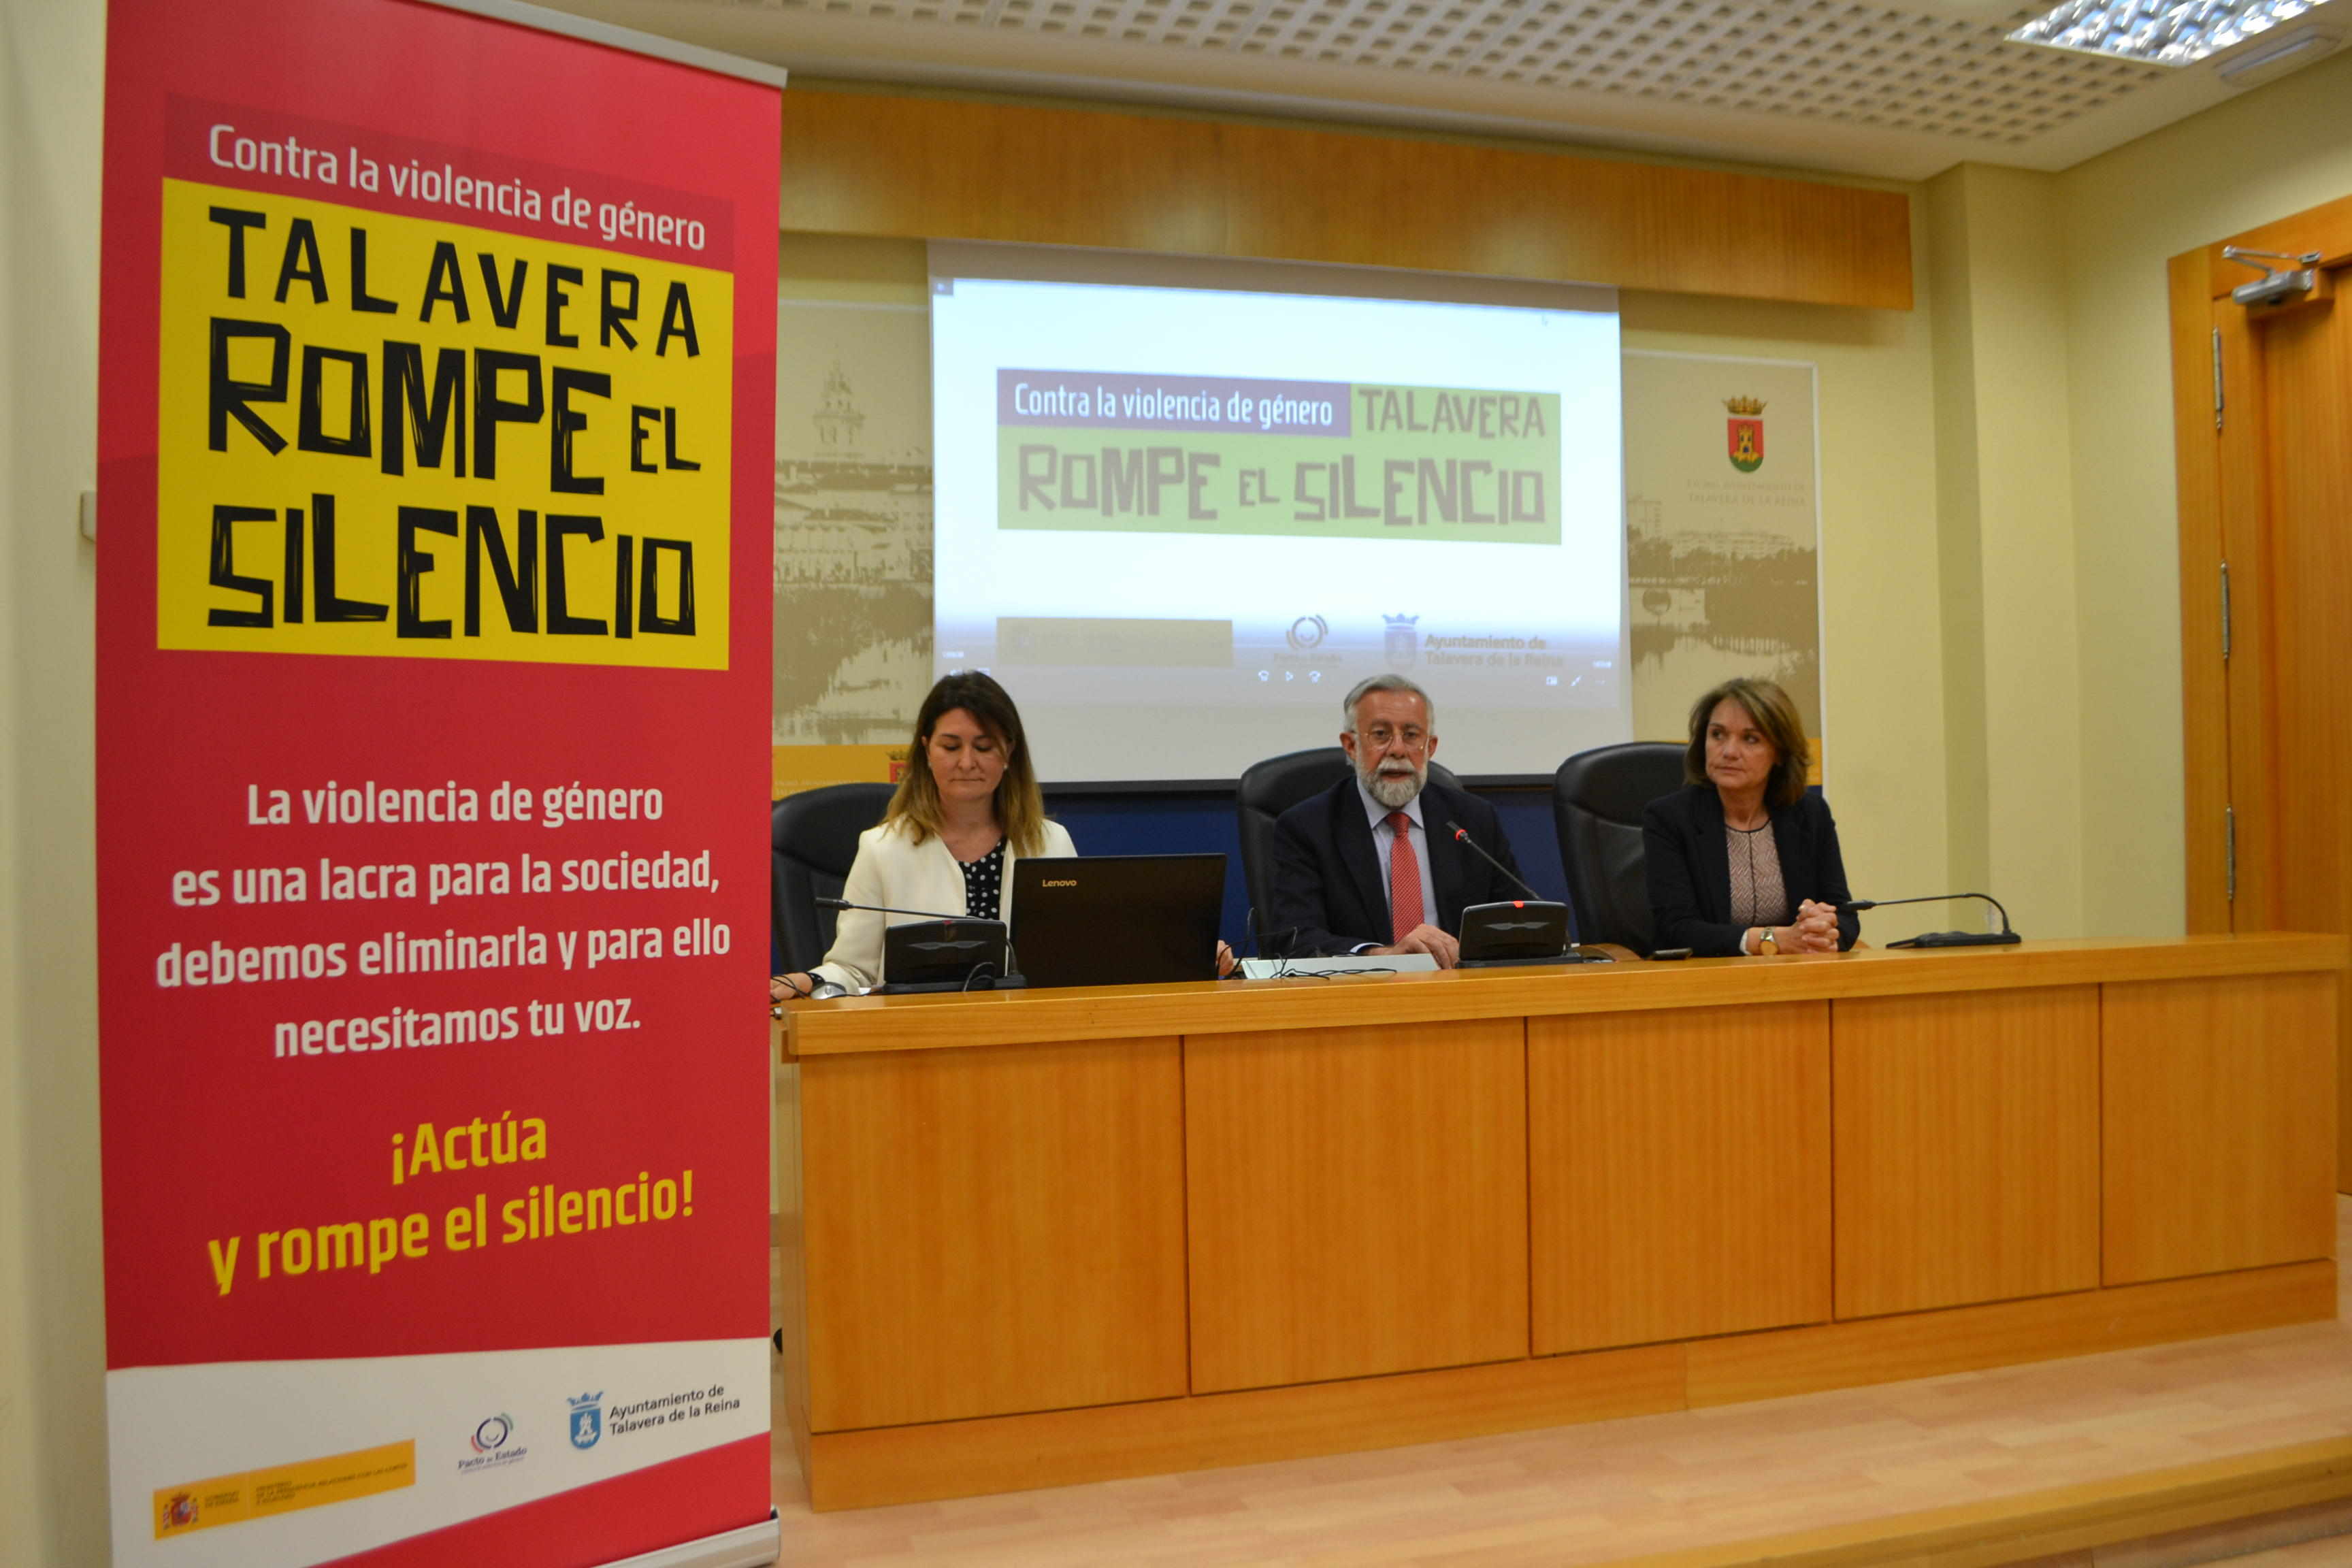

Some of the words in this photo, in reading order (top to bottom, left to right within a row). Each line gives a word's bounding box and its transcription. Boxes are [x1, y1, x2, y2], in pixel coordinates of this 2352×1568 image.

[210, 124, 338, 184] Contra
[350, 147, 380, 193] la
[389, 162, 542, 223] violencia
[551, 187, 589, 229] de
[599, 201, 706, 250] género
[208, 205, 701, 359] TALAVERA
[208, 316, 611, 495] ROMPE
[630, 404, 701, 474] EL
[1013, 382, 1090, 417] Contra
[1096, 386, 1116, 419] la
[1122, 387, 1221, 422] violencia
[1227, 394, 1254, 423] de
[1259, 395, 1333, 429] género
[1358, 387, 1546, 438] TALAVERA
[1018, 444, 1221, 521] ROMPE
[1239, 468, 1279, 507] EL
[1293, 454, 1546, 527] SILENCIO
[208, 492, 696, 639] SILENCIO
[1425, 634, 1525, 651] Ayuntamiento
[1528, 635, 1546, 649] de
[247, 784, 291, 826] La
[304, 781, 478, 823] violencia
[489, 781, 532, 822] de
[542, 781, 664, 828] género
[172, 868, 220, 907] es
[233, 865, 307, 904] una
[320, 858, 416, 901] lacra
[429, 861, 509, 904] para
[521, 854, 551, 893] la
[560, 849, 719, 894] sociedad,
[1043, 879, 1077, 887] Lenovo
[156, 939, 347, 987] debemos
[359, 926, 546, 976] eliminarla
[558, 928, 577, 971] y
[587, 924, 662, 968] para
[672, 917, 731, 957] ello
[275, 1005, 519, 1057] necesitamos
[528, 998, 565, 1036] tu
[574, 998, 641, 1032] voz.
[391, 1111, 546, 1185] ¡Actúa
[208, 1236, 240, 1296] y
[257, 1212, 429, 1279] rompe
[444, 1194, 487, 1252] el
[502, 1170, 694, 1244] silencio!
[609, 1389, 704, 1419] Ayuntamiento
[708, 1384, 725, 1397] de
[610, 1414, 665, 1436] Talavera
[668, 1409, 685, 1422] de
[688, 1405, 701, 1418] la
[704, 1398, 740, 1415] Reina
